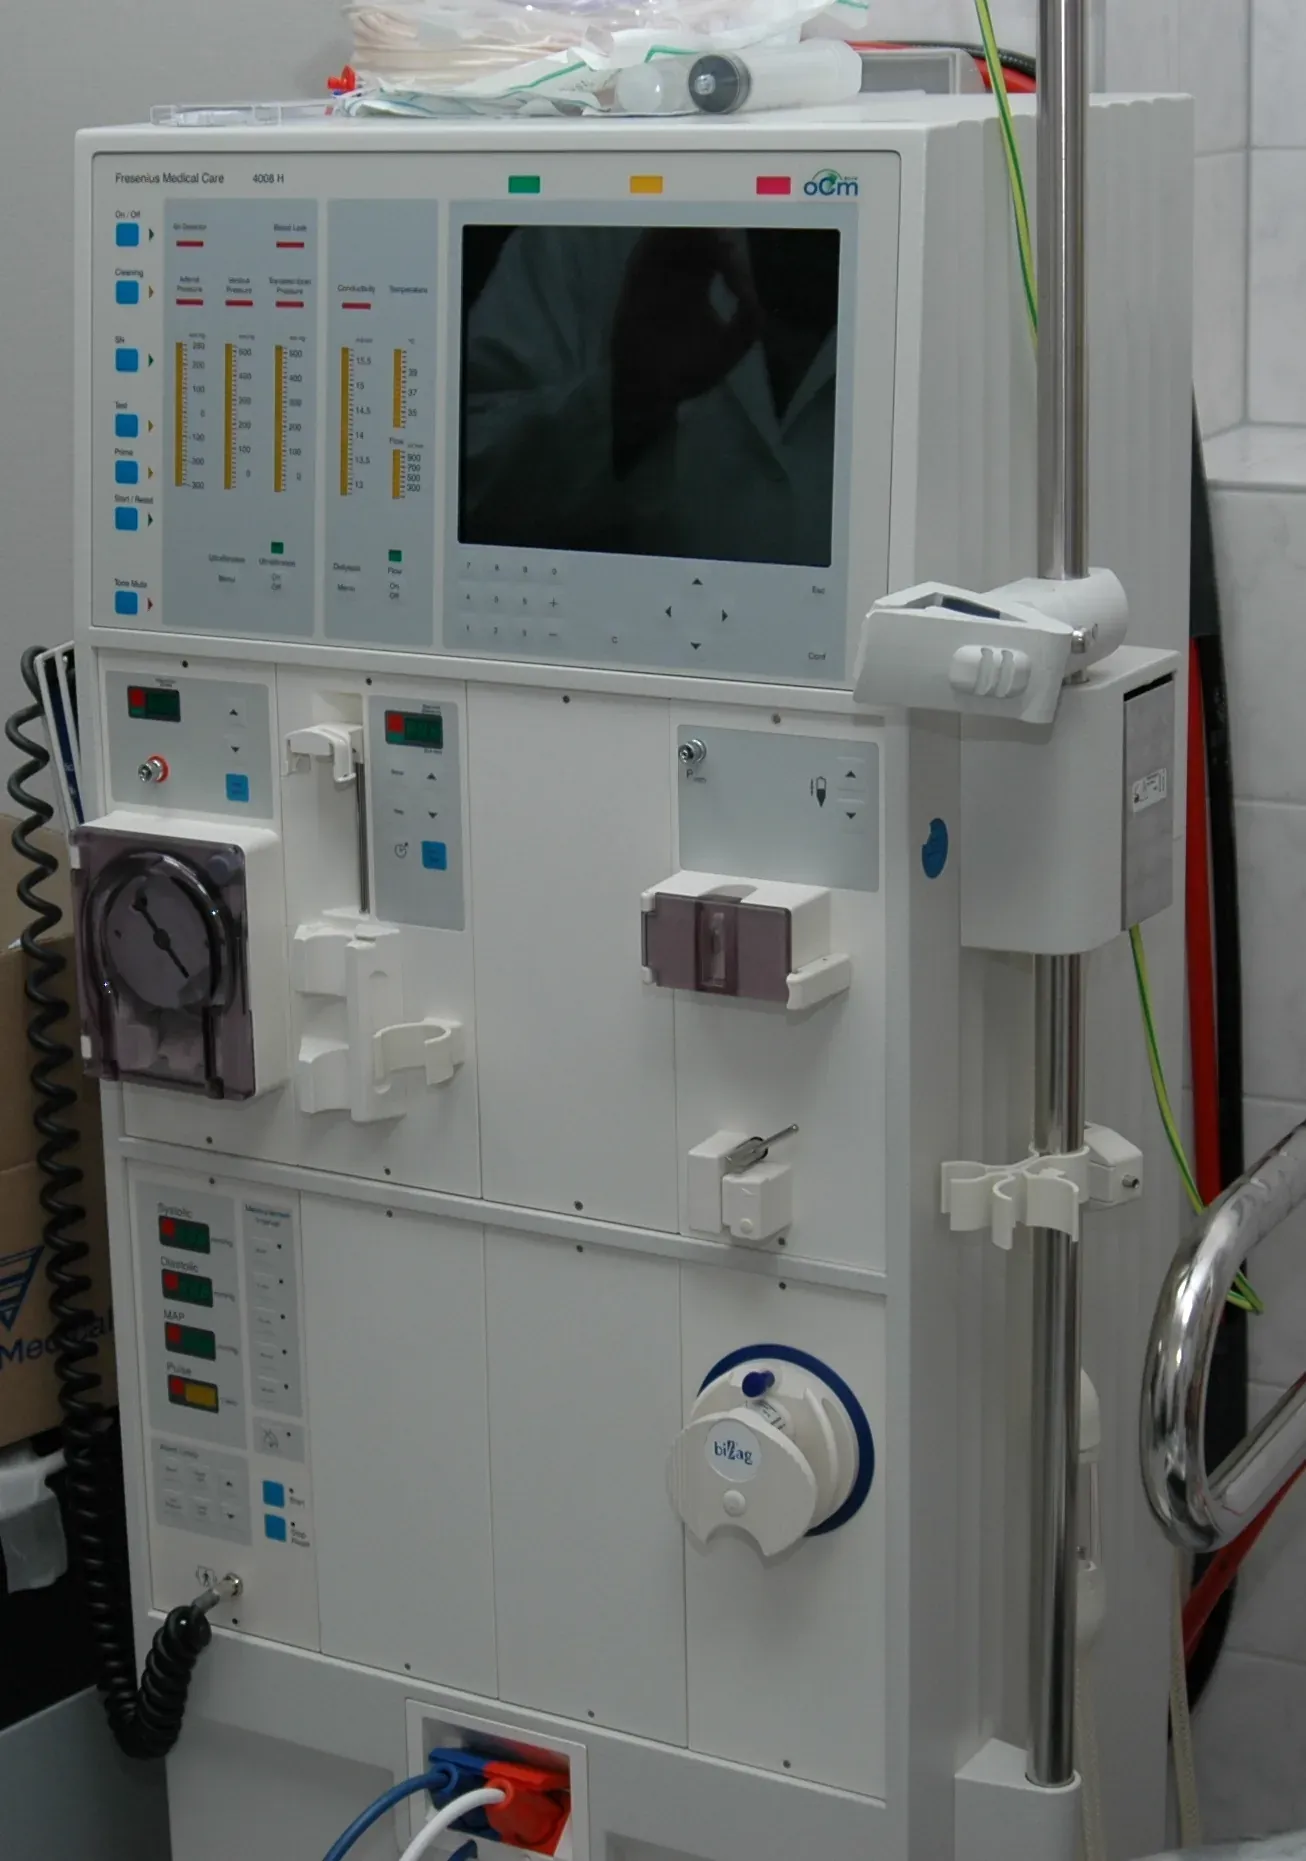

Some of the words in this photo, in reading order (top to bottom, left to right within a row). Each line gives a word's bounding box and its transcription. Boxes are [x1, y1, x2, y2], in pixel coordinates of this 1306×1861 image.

[115, 172, 160, 184] Fresenius
[162, 172, 199, 184] Medical
[201, 172, 225, 184] Care
[252, 173, 275, 184] 4008
[277, 174, 285, 183] H
[115, 268, 144, 278] Cleaning
[355, 431, 364, 440] 14
[114, 448, 133, 457] Prime
[407, 484, 421, 493] 300
[163, 1309, 186, 1321] MAP
